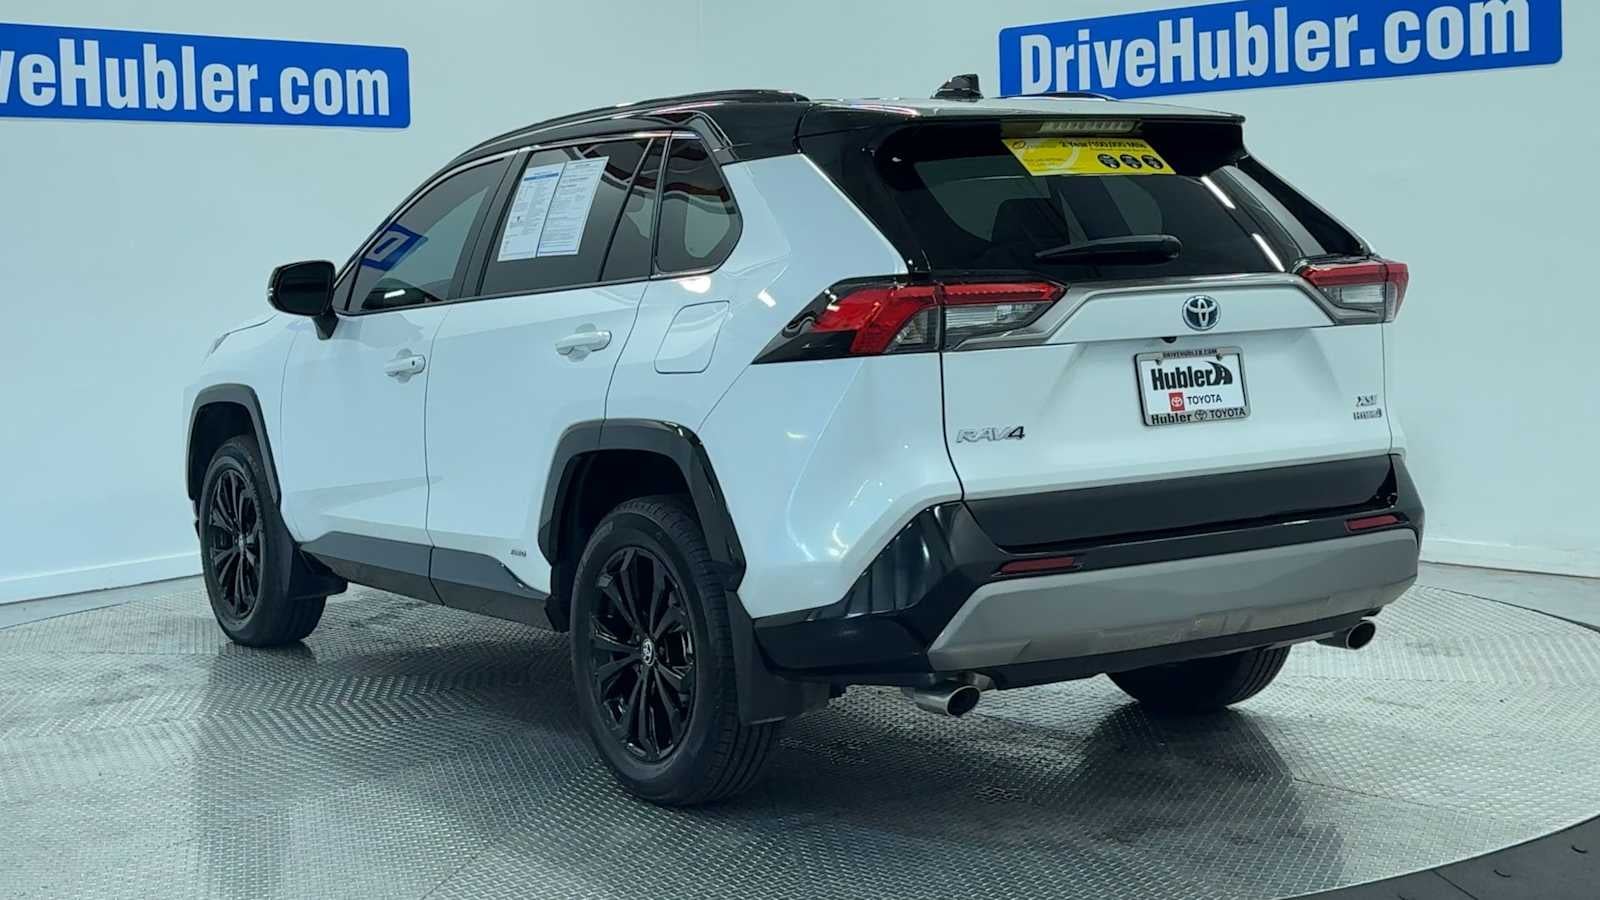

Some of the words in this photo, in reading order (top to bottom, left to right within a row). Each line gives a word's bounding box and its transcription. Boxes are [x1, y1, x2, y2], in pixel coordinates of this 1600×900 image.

[1020, 0, 1530, 96] DriveHubler.com
[1150, 365, 1213, 391] Hubler
[1186, 394, 1223, 405] TOYOTA
[1151, 411, 1192, 424] Hubler
[1206, 407, 1246, 419] TOYOTA
[956, 425, 1025, 443] RAV4
